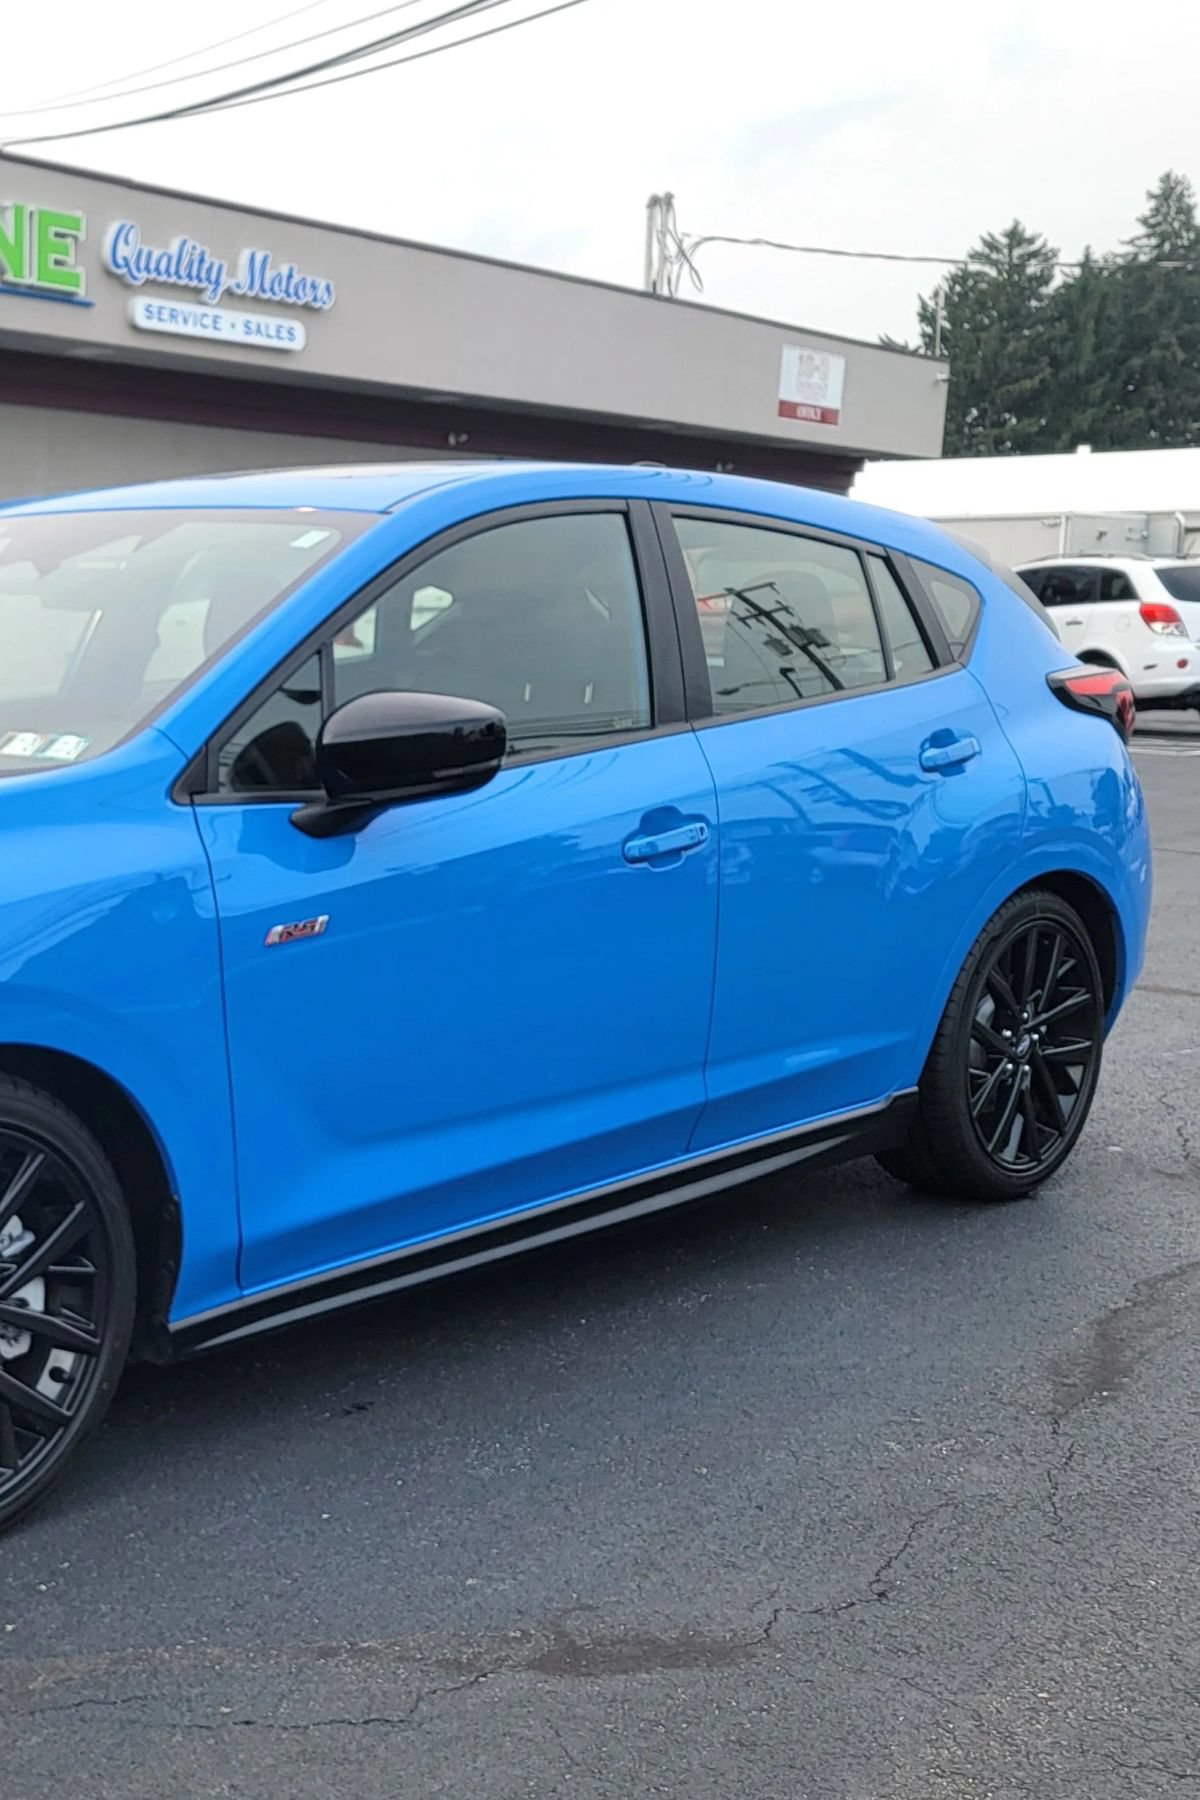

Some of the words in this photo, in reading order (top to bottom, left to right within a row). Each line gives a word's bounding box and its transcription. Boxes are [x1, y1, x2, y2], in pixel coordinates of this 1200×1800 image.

[108, 220, 225, 301] Quality
[236, 249, 335, 307] Motors
[143, 303, 223, 331] SERVICE
[242, 319, 297, 342] SALES
